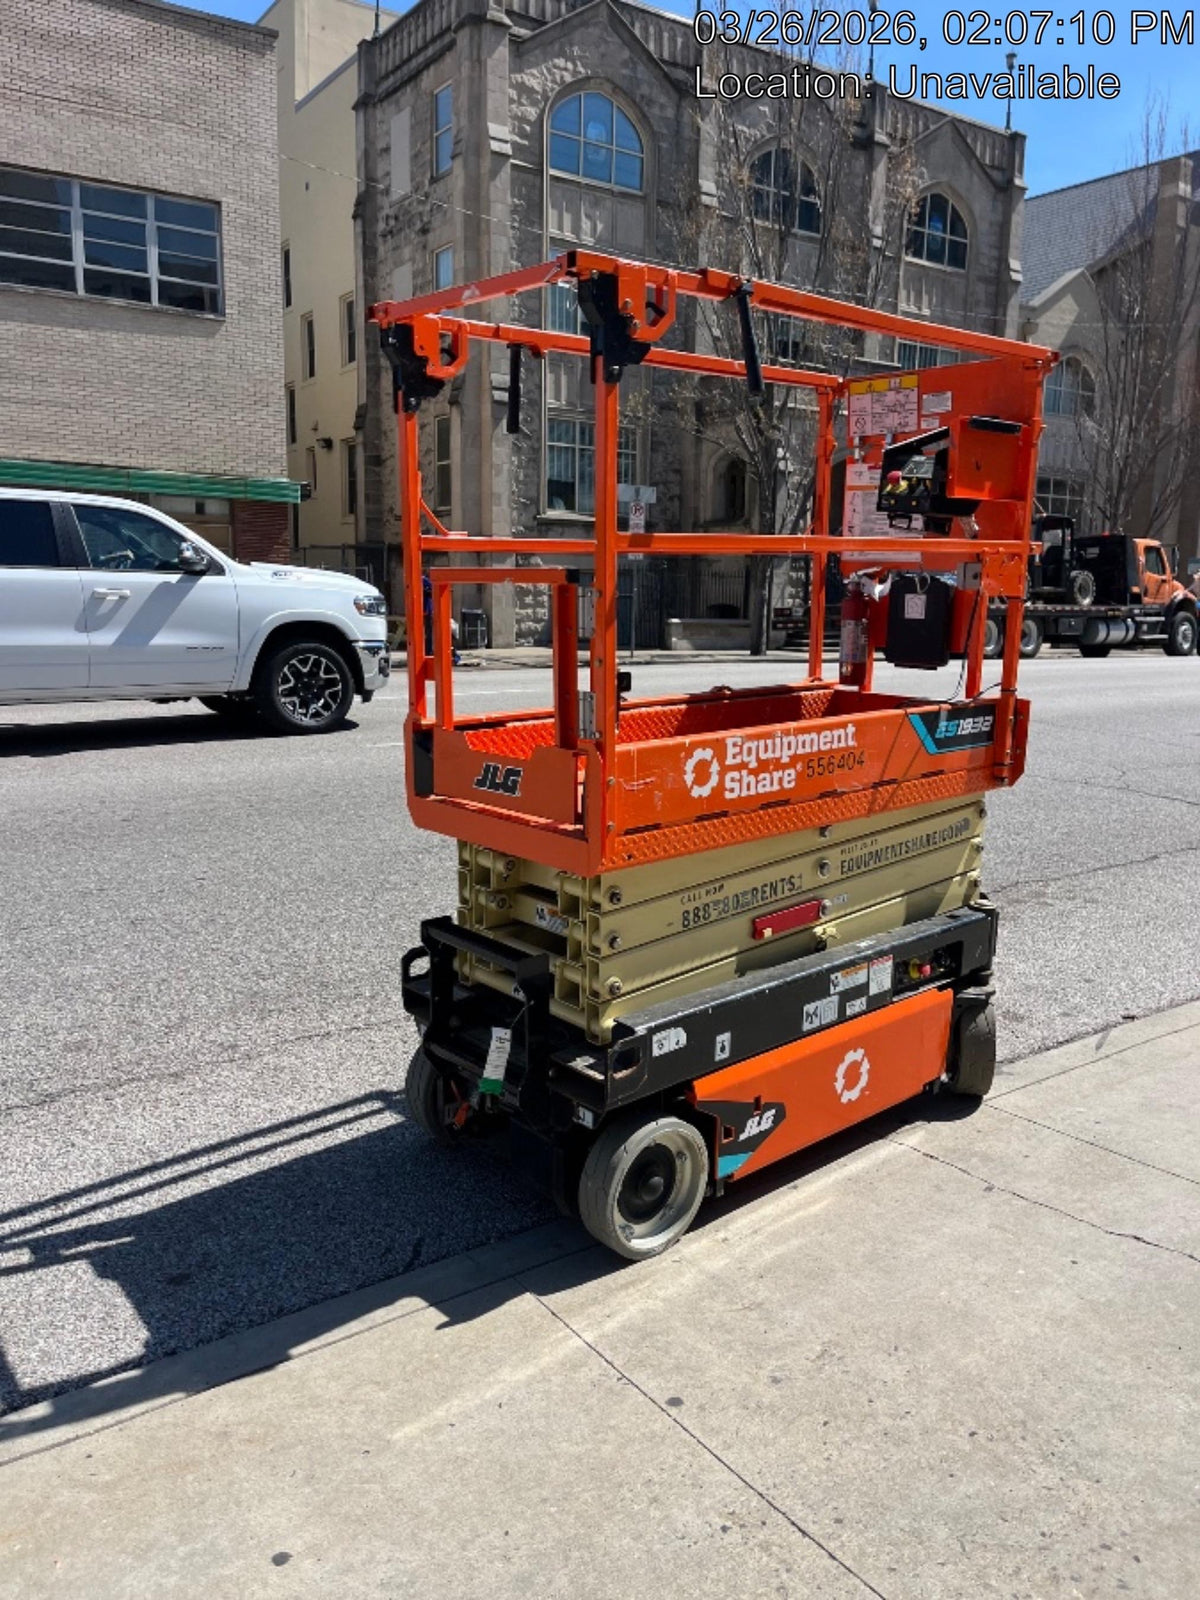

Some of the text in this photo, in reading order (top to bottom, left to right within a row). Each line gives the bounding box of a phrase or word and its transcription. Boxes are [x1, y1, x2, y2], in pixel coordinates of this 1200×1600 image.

[725, 723, 857, 768] Equipment
[473, 762, 523, 797] JLG
[806, 750, 865, 778] 556404
[724, 767, 797, 799] Share
[738, 1109, 776, 1142] JLG
